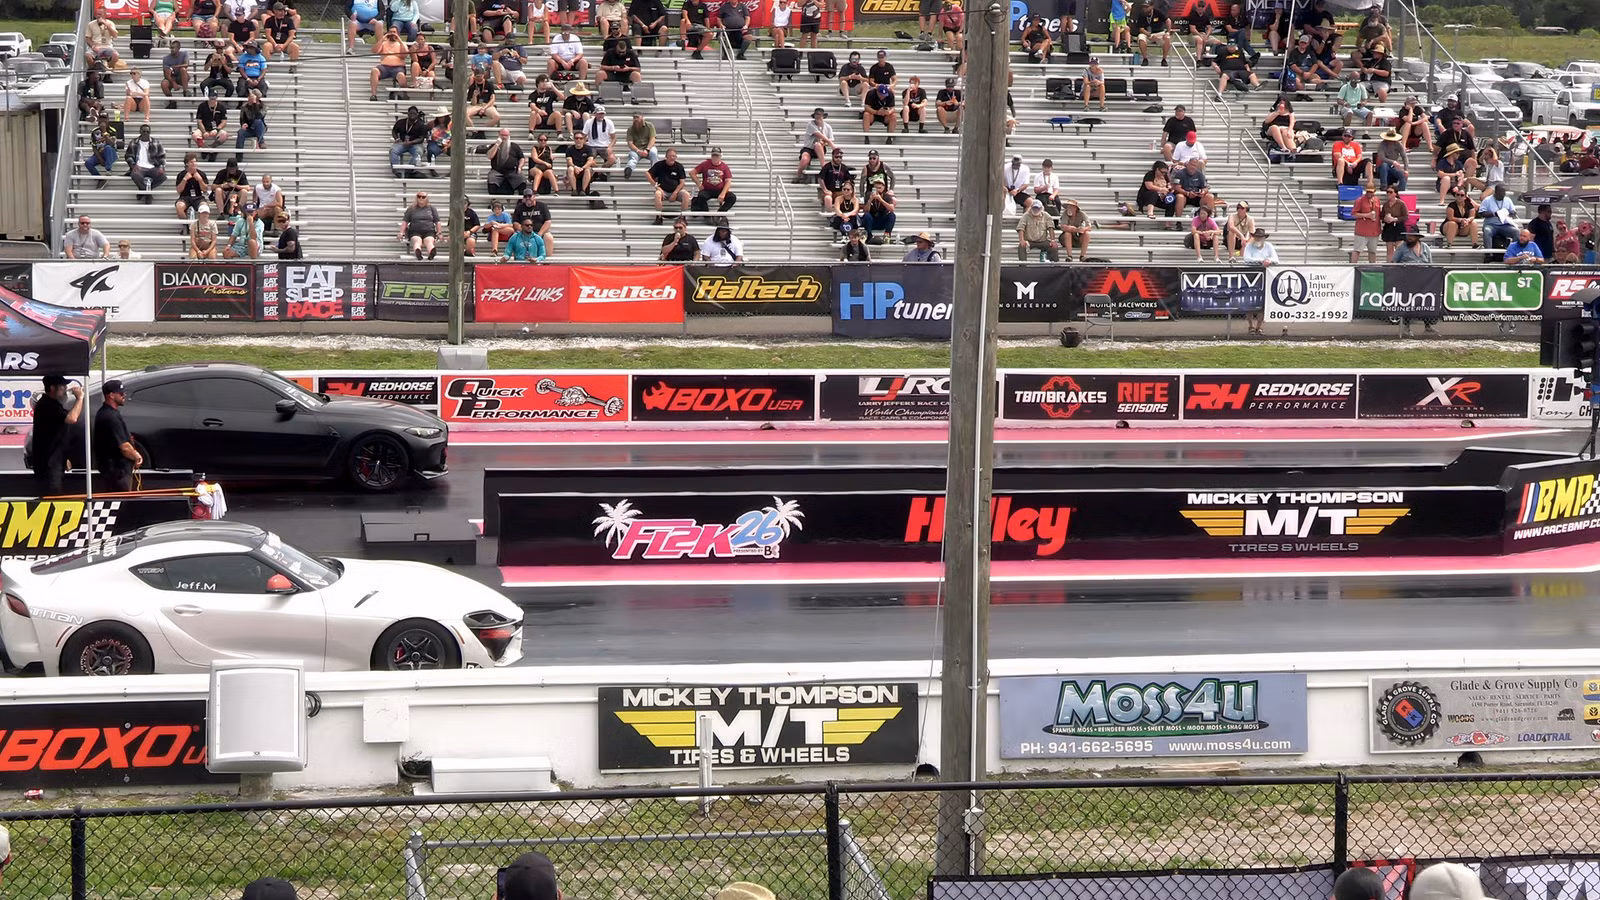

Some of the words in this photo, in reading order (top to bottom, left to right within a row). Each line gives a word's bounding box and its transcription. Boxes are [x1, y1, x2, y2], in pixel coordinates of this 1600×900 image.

[163, 272, 247, 287] DIAMOND
[286, 265, 344, 288] EAT
[1183, 273, 1262, 289] MOTIV
[1309, 273, 1327, 281] Law
[202, 286, 249, 296] Pistons
[384, 284, 449, 299] FFR
[694, 277, 821, 301] Haltech
[1309, 282, 1336, 290] Injury
[1453, 282, 1513, 302] REAL
[1517, 277, 1533, 288] ST
[286, 287, 344, 302] SLEEP
[481, 287, 524, 302] FRESH
[524, 287, 565, 302] LINKS
[578, 285, 678, 303] FuelTech
[840, 282, 905, 320] HP
[893, 300, 953, 321] tuner
[1308, 290, 1350, 298] Attorneys
[1359, 287, 1436, 307] radium
[287, 300, 344, 318] RACE
[1269, 310, 1348, 320] 800-332-1992
[1443, 313, 1543, 322] www.RealStreetPerformance.com
[0, 352, 40, 370] RS
[369, 381, 435, 391] REDHORSE
[1117, 382, 1169, 402] RIFE
[1255, 383, 1353, 396] REDHORSE
[665, 388, 773, 411] BOXO
[767, 400, 803, 411] USA
[1249, 401, 1346, 410] PERFORMANCE
[864, 408, 893, 416] World
[1117, 402, 1169, 413] SENSORS
[1537, 406, 1573, 419] Tony
[1187, 492, 1273, 505] MICKEY
[1276, 491, 1404, 504] THOMPSON
[1533, 475, 1594, 522] BMP
[0, 501, 85, 548] MP
[731, 510, 784, 546] 26
[904, 496, 1071, 556] Hley
[1244, 506, 1357, 538] M/T
[1228, 543, 1279, 552] TIRES
[1281, 543, 1293, 552] &
[1295, 542, 1359, 551] WHEELS
[175, 581, 216, 591] Jeff.M
[1450, 679, 1480, 691] Glade
[1482, 680, 1491, 690] &
[1494, 679, 1525, 690] Grove
[1527, 678, 1561, 691] Supply
[1564, 678, 1578, 689] Co
[622, 686, 733, 707] MICKEY
[738, 684, 899, 705] THOMPSON
[1381, 701, 1389, 725] GLADE
[1392, 686, 1417, 695] GROVE
[1418, 689, 1437, 711] SUPPLY
[1430, 713, 1437, 725] CO
[1447, 714, 1475, 723] WOODS
[695, 706, 837, 748] M/T
[1517, 734, 1541, 742] LOAD
[1546, 733, 1573, 741] TRAIL
[0, 725, 192, 771] BOXO
[1020, 742, 1045, 754] PH:
[1048, 740, 1153, 754] 941-662-5695
[1168, 738, 1291, 751] www.moss4u.com
[740, 749, 756, 764] &
[760, 747, 850, 764] WHEELS
